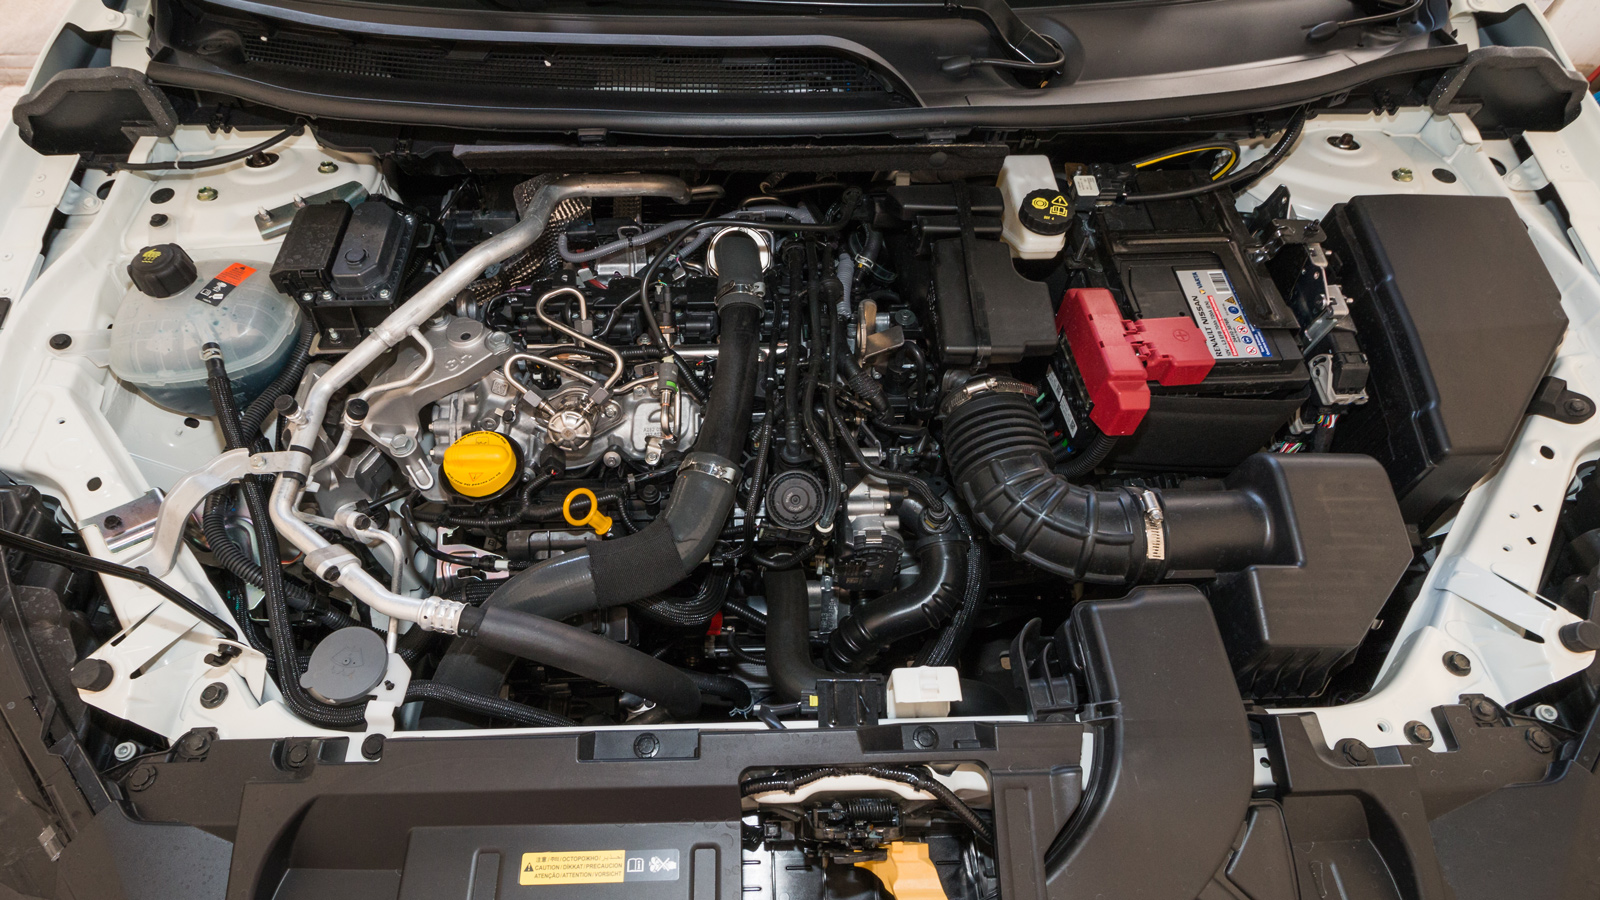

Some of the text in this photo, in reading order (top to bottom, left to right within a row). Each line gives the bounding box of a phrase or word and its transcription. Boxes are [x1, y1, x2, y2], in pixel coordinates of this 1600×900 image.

[1192, 272, 1203, 289] VARTA
[1191, 295, 1223, 357] RENAULT NISSAN
